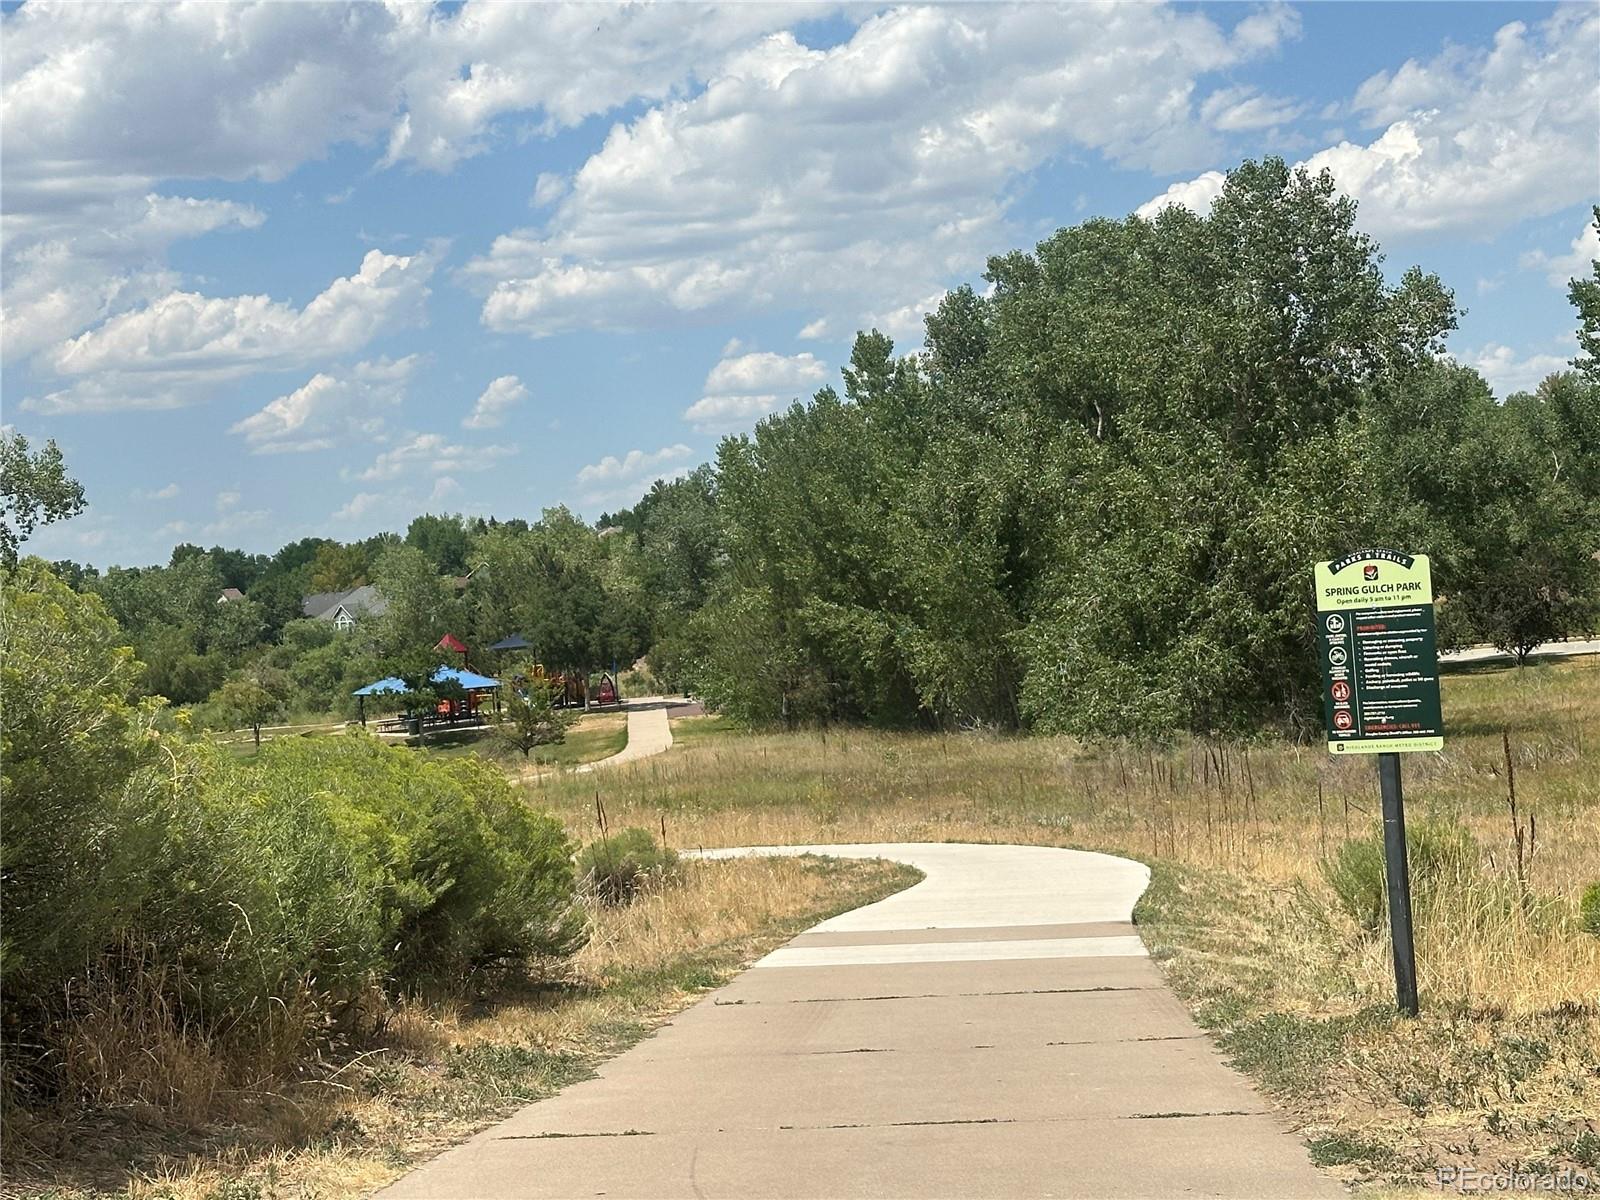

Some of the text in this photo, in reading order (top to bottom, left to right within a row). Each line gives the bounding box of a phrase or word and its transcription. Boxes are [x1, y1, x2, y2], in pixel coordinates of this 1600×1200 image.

[1335, 554, 1362, 570] PARKS
[1375, 552, 1408, 564] TRAILS
[1326, 582, 1422, 596] SPRING GULCH PARK
